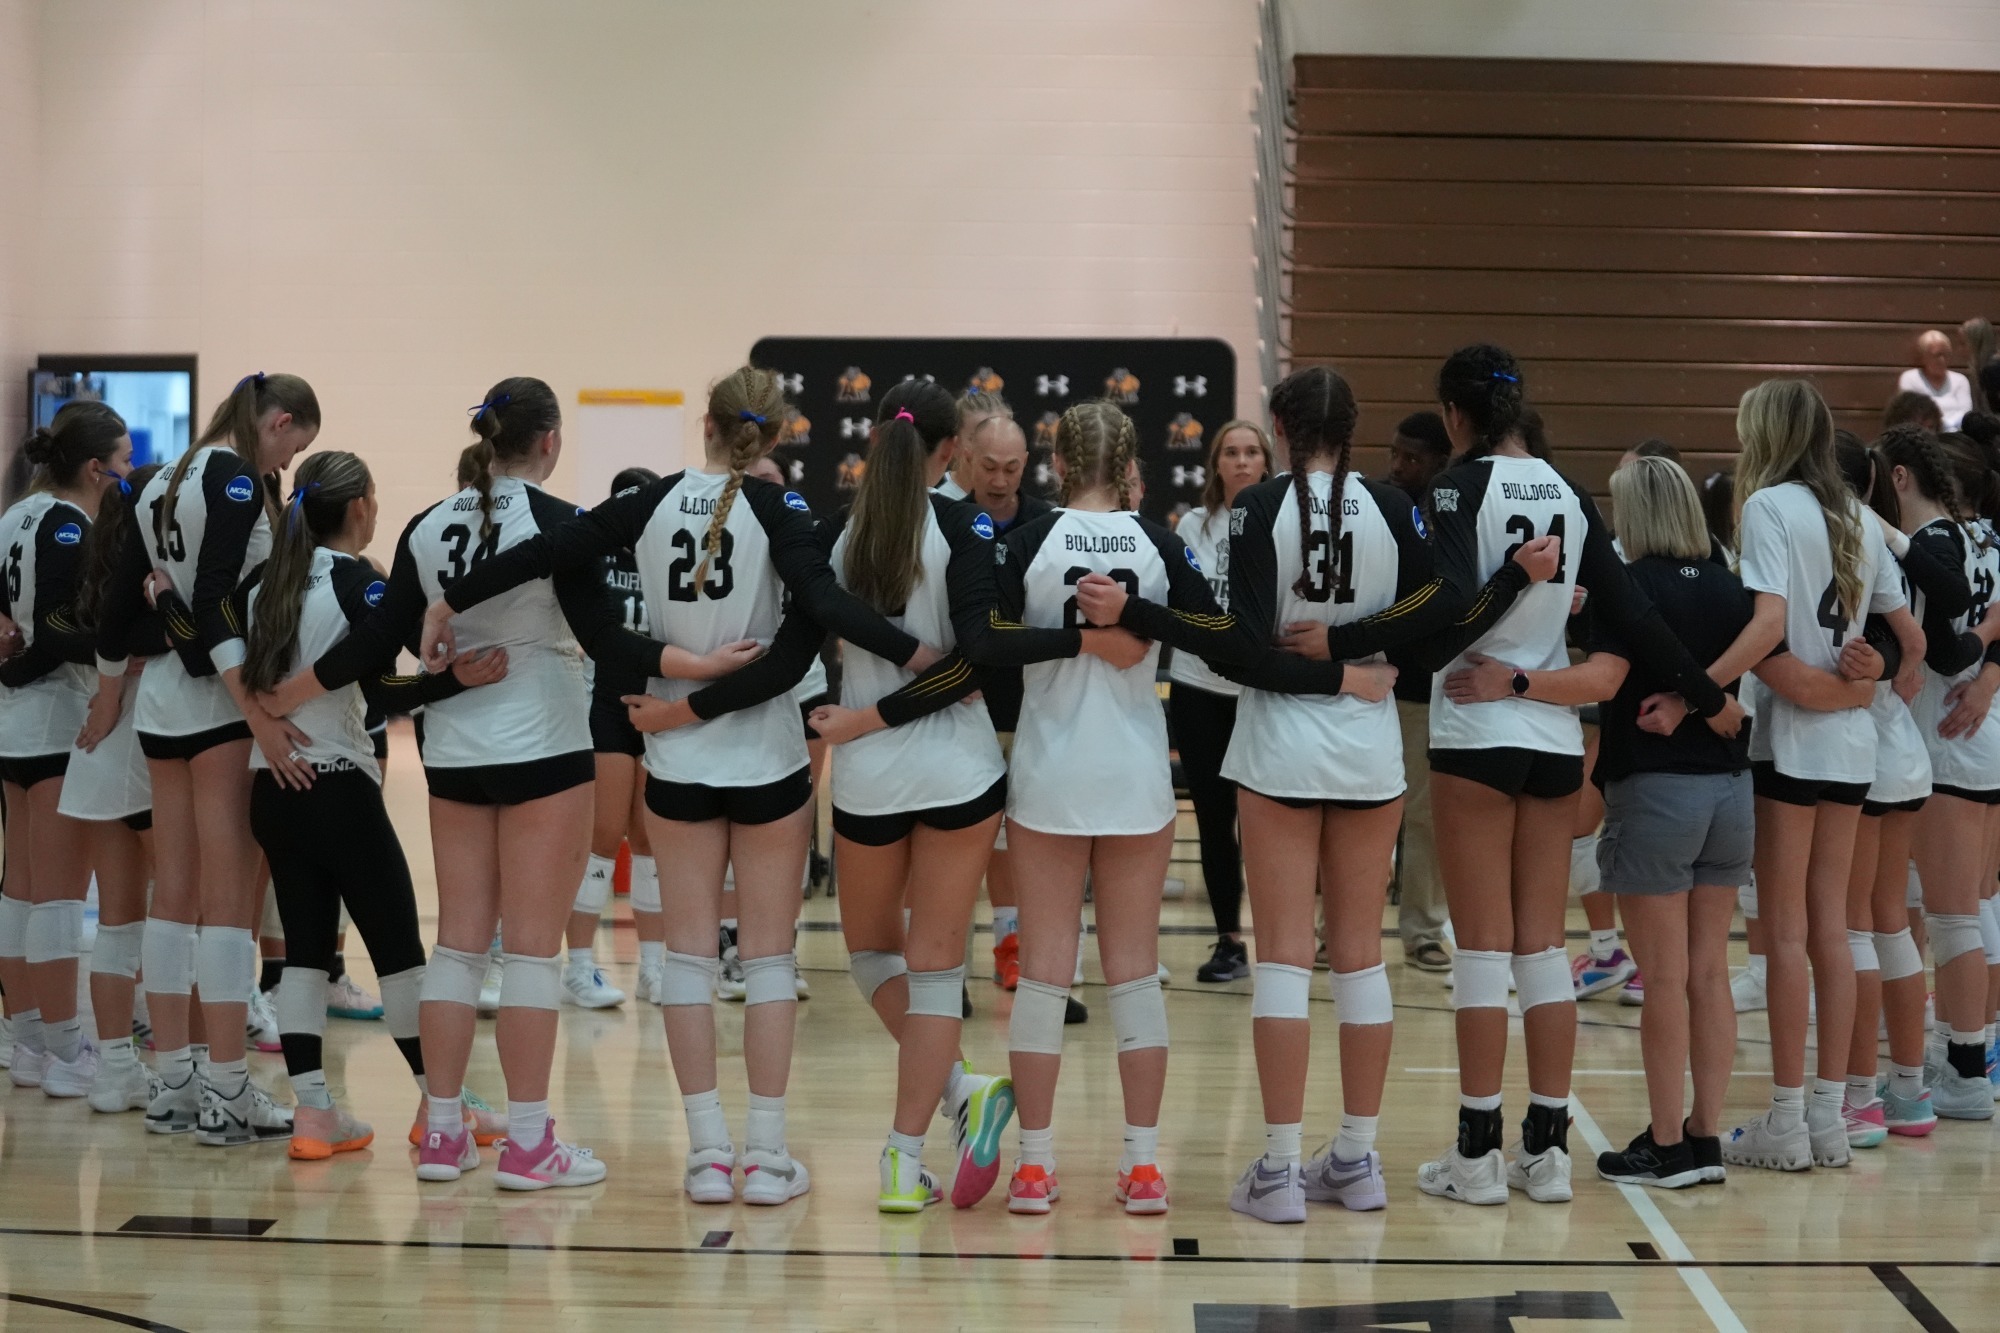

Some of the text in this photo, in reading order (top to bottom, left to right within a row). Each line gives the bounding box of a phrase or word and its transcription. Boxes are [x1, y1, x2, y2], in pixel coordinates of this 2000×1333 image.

[228, 486, 253, 498] NCAA
[1501, 482, 1562, 501] BULLDOGS
[453, 495, 513, 512] BULGS
[57, 531, 81, 542] NCAA
[1064, 534, 1137, 554] BULLDOGS
[1504, 512, 1567, 584] 24
[668, 527, 735, 602] 23
[1305, 530, 1356, 605] 31
